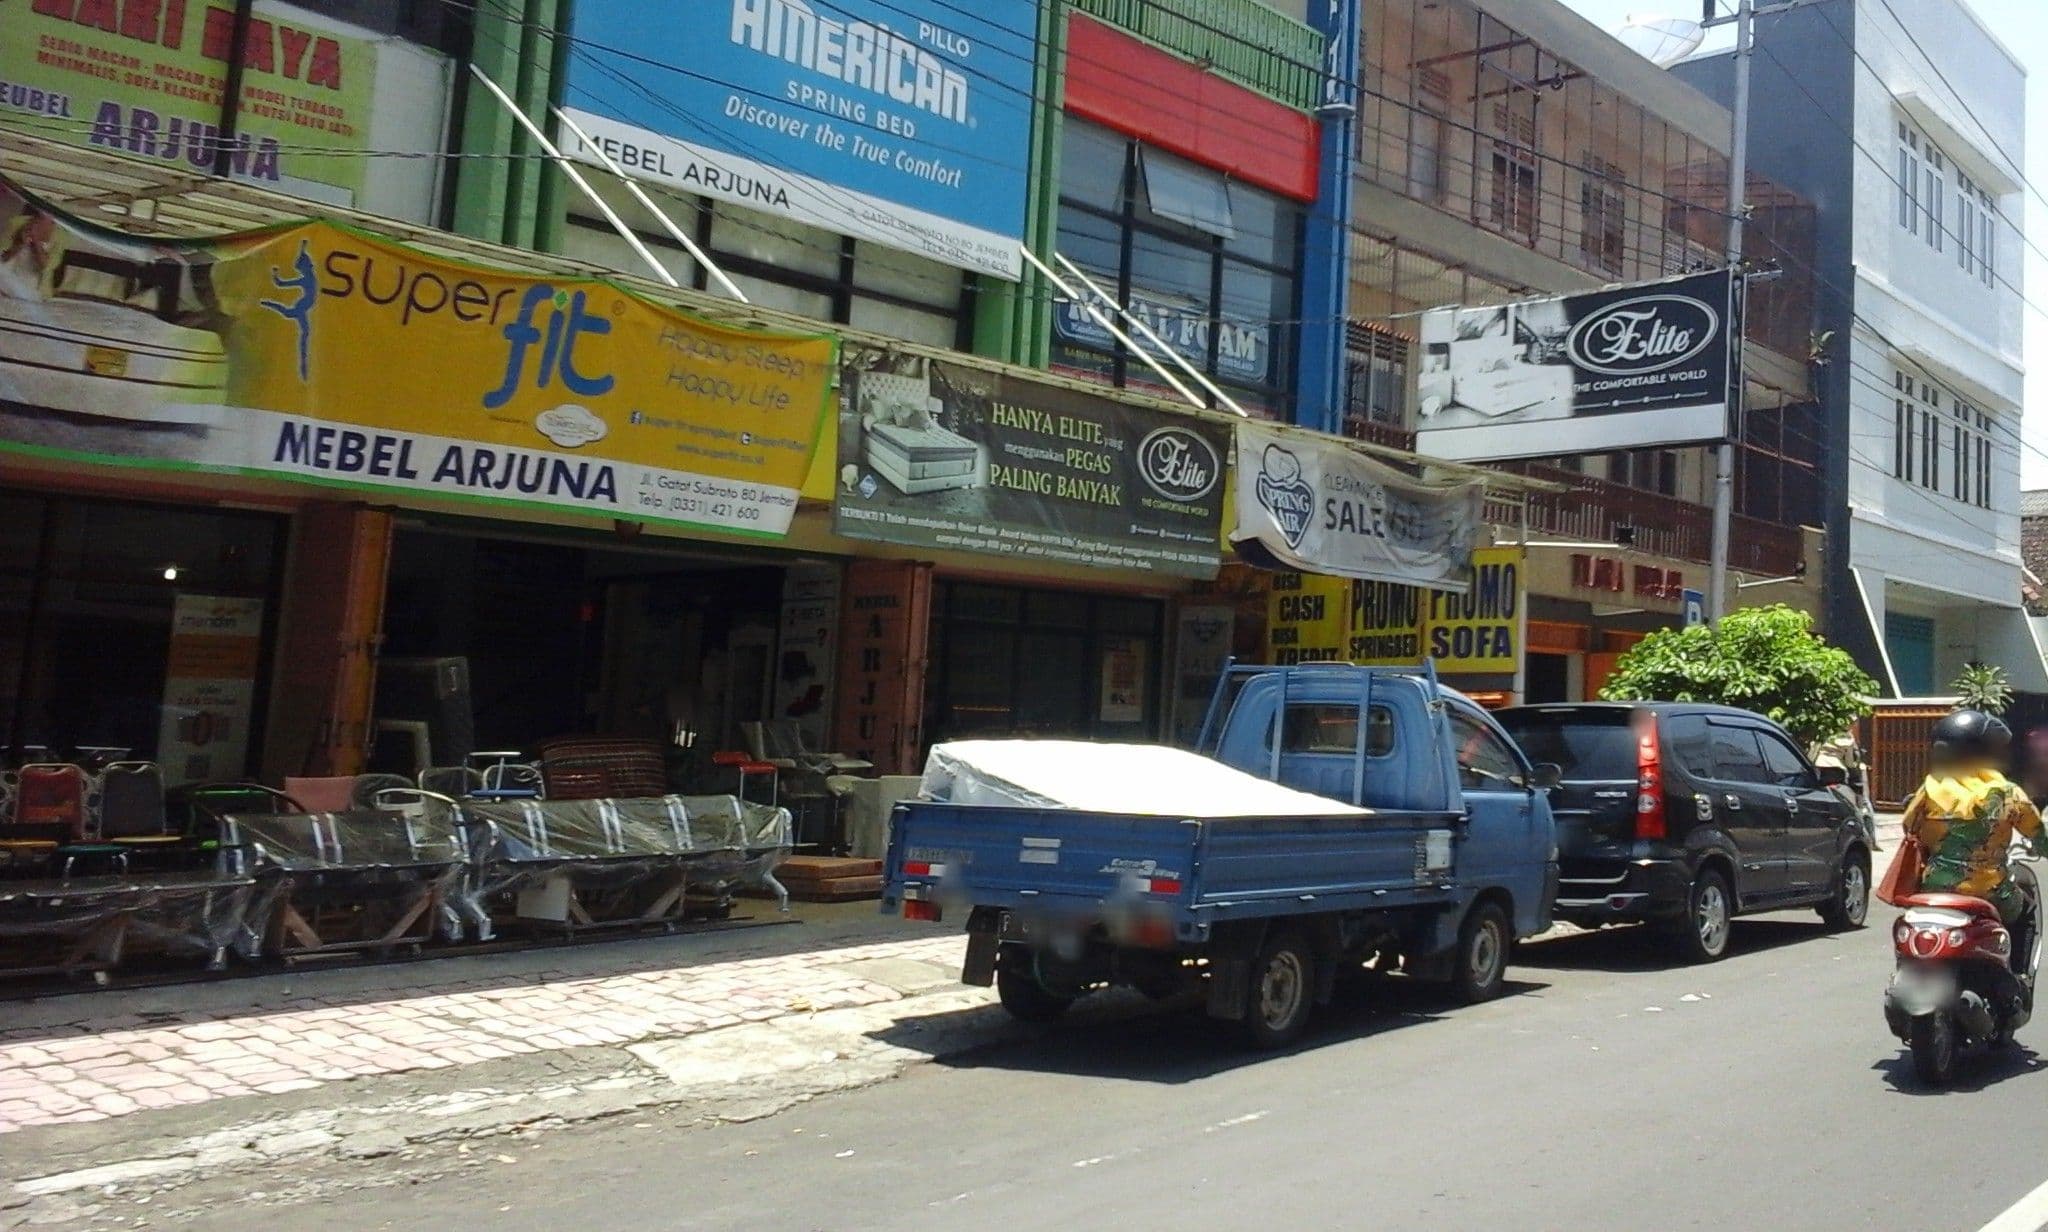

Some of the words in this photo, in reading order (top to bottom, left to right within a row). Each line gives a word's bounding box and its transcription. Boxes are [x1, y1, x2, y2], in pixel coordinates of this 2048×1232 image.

[919, 21, 970, 58] PILLO
[787, 80, 866, 122] SPRING
[876, 110, 924, 138] BED
[725, 95, 809, 138] Discover
[815, 123, 846, 151] the
[852, 135, 890, 164] True
[895, 149, 962, 188] Comfort
[577, 134, 673, 177] MEBEL
[683, 162, 790, 209] ARJUNA
[658, 325, 741, 364] Happy
[743, 344, 807, 381] Sleep
[1583, 306, 1691, 363] Elite
[667, 367, 743, 406] Happy
[749, 382, 791, 413] Life
[1593, 374, 1667, 392] COMFORTABLE
[1668, 369, 1708, 382] WORLD
[991, 402, 1054, 435] HANYA
[1059, 416, 1104, 444] ELITE
[273, 420, 418, 480] MEBEL
[431, 445, 619, 504] ARJUNA
[1066, 447, 1112, 475] PEGAS
[1148, 435, 1207, 490] Elite
[657, 475, 693, 493] Gatot
[695, 481, 738, 500] Subroto
[741, 488, 757, 502] 80
[990, 463, 1053, 496] PALING
[1056, 475, 1121, 507] BANYAK
[1262, 483, 1310, 513] SPRING
[711, 502, 733, 518] 421
[736, 507, 761, 521] 600
[1278, 594, 1325, 622] CASH
[1430, 625, 1512, 659] SOFA
